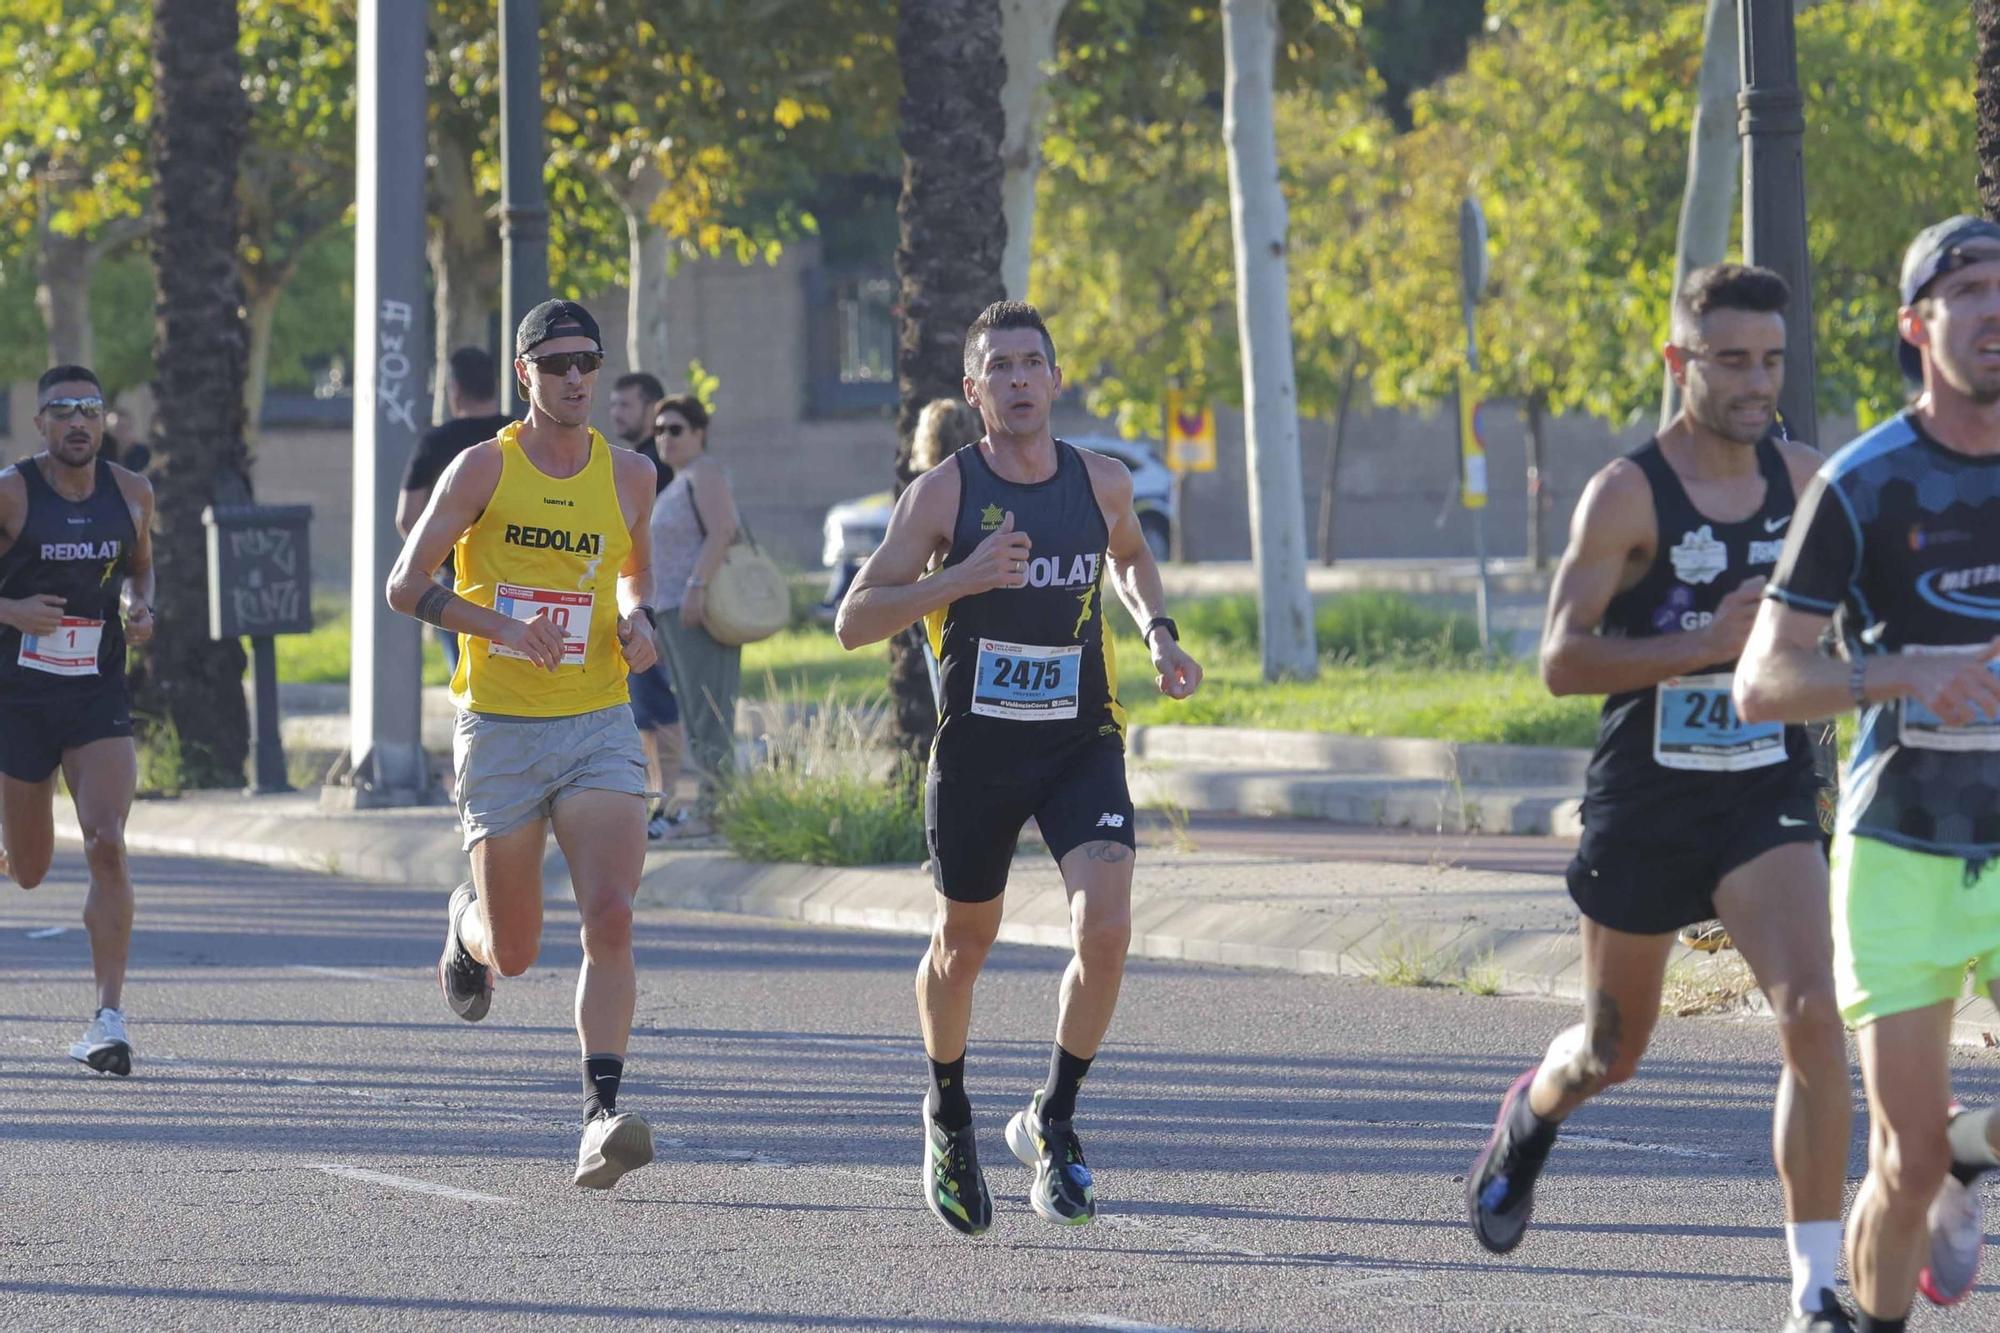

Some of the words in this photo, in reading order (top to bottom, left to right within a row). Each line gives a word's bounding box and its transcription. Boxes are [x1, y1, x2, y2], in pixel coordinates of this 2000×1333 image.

[40, 541, 118, 560] REDOLAT
[505, 524, 600, 555] REDOLAT
[66, 629, 75, 648] 1
[993, 657, 1060, 690] 2475
[1684, 692, 1740, 729] 24
